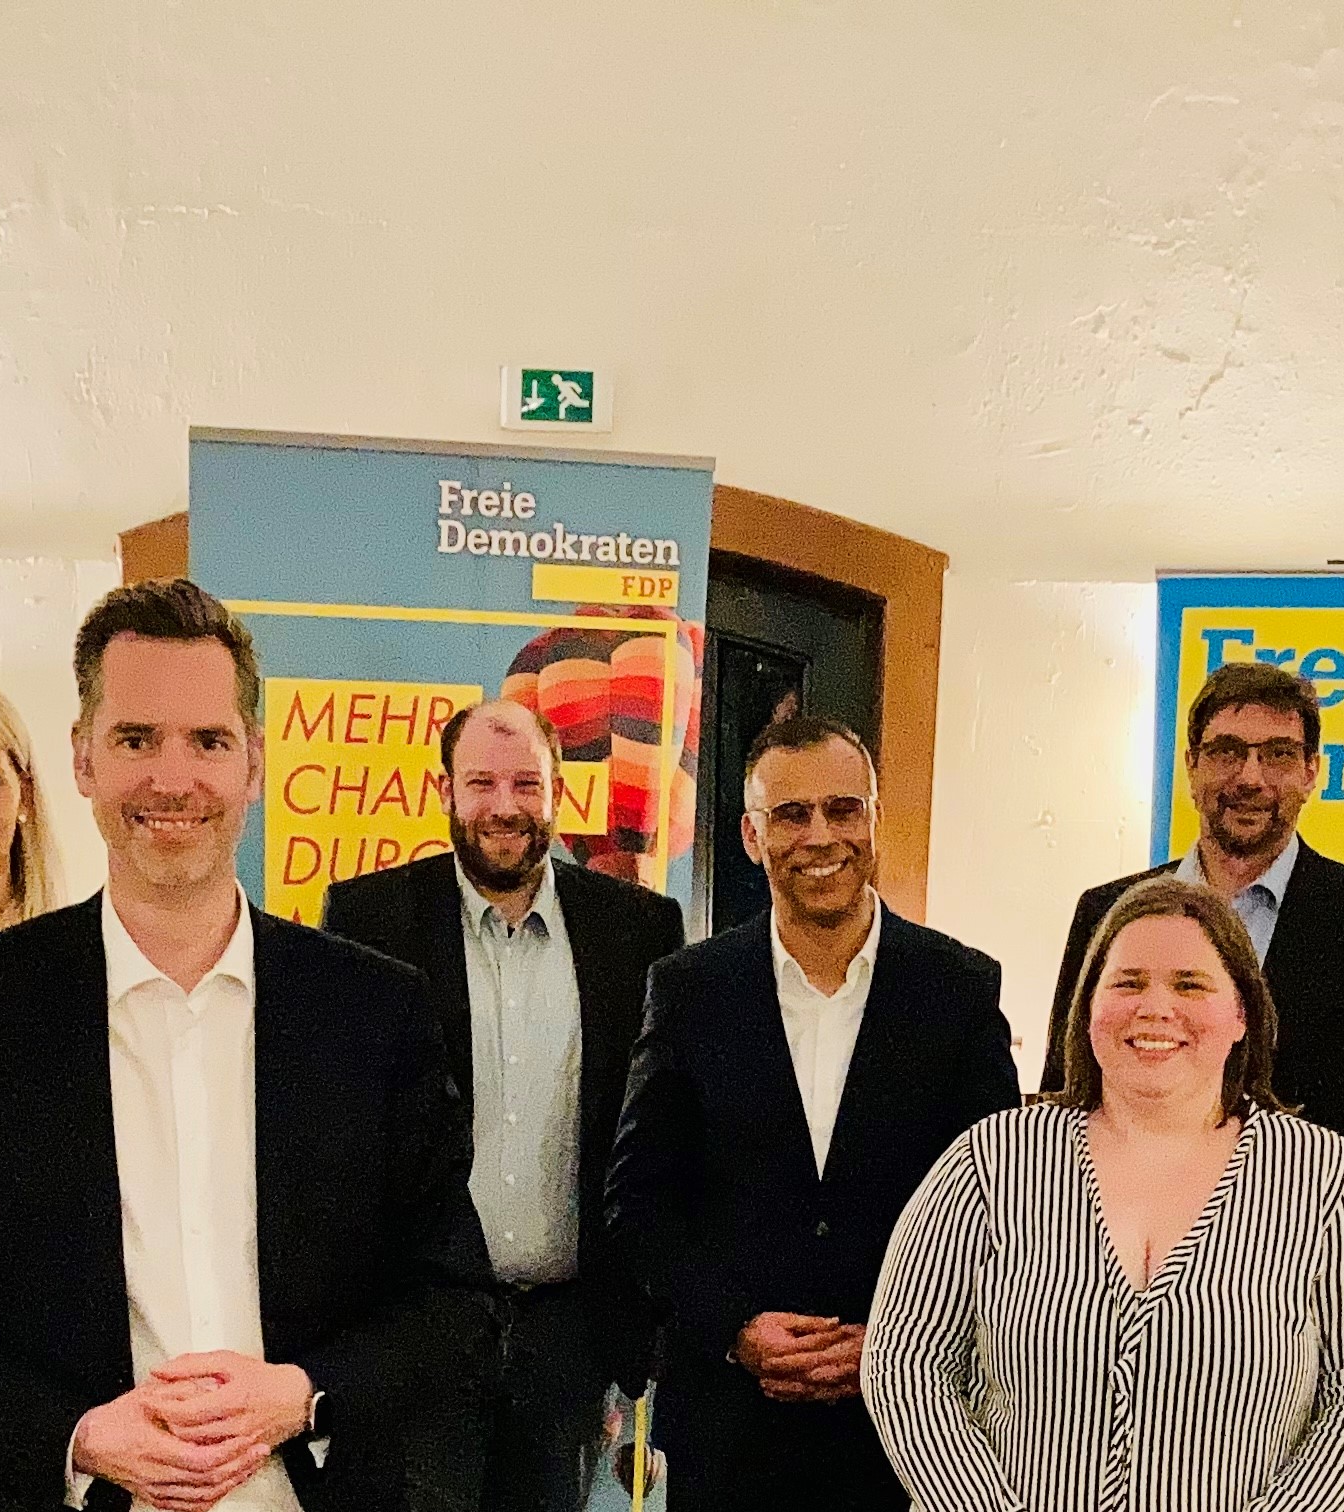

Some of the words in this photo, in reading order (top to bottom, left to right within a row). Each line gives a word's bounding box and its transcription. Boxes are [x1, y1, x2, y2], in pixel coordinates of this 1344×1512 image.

[438, 480, 536, 519] Freie
[437, 519, 680, 566] Demokraten
[621, 576, 673, 599] FDP
[282, 690, 454, 746] MEHR
